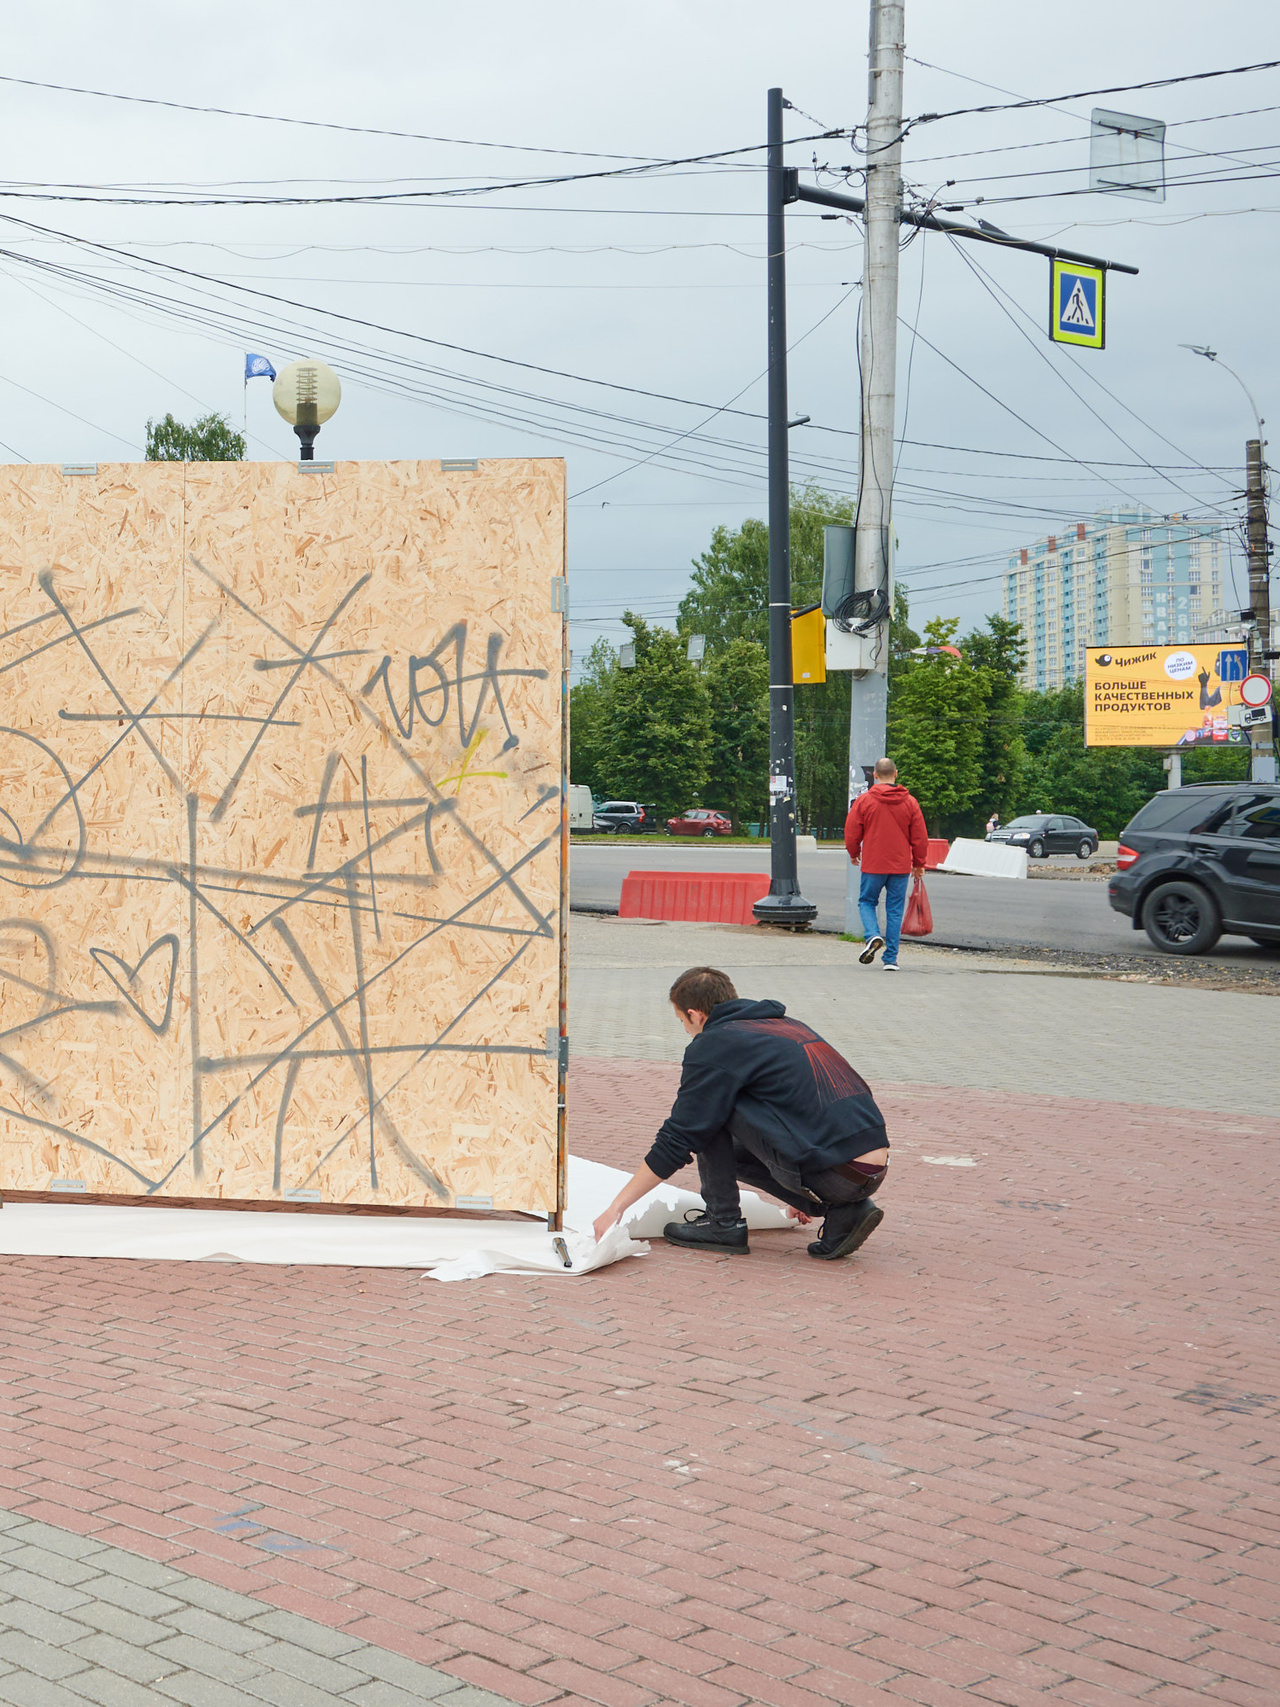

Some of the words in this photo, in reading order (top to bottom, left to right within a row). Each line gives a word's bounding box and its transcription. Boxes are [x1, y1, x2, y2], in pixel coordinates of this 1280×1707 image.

[1167, 661, 1193, 669] НИЗКИМ
[1169, 666, 1192, 674] ЦЕНАМ
[1094, 681, 1147, 690] БОЛЬШЕ
[1094, 691, 1194, 701] КАЧЕСТВЕННЫХ
[1094, 702, 1171, 713] ПРОДУКТОВ
